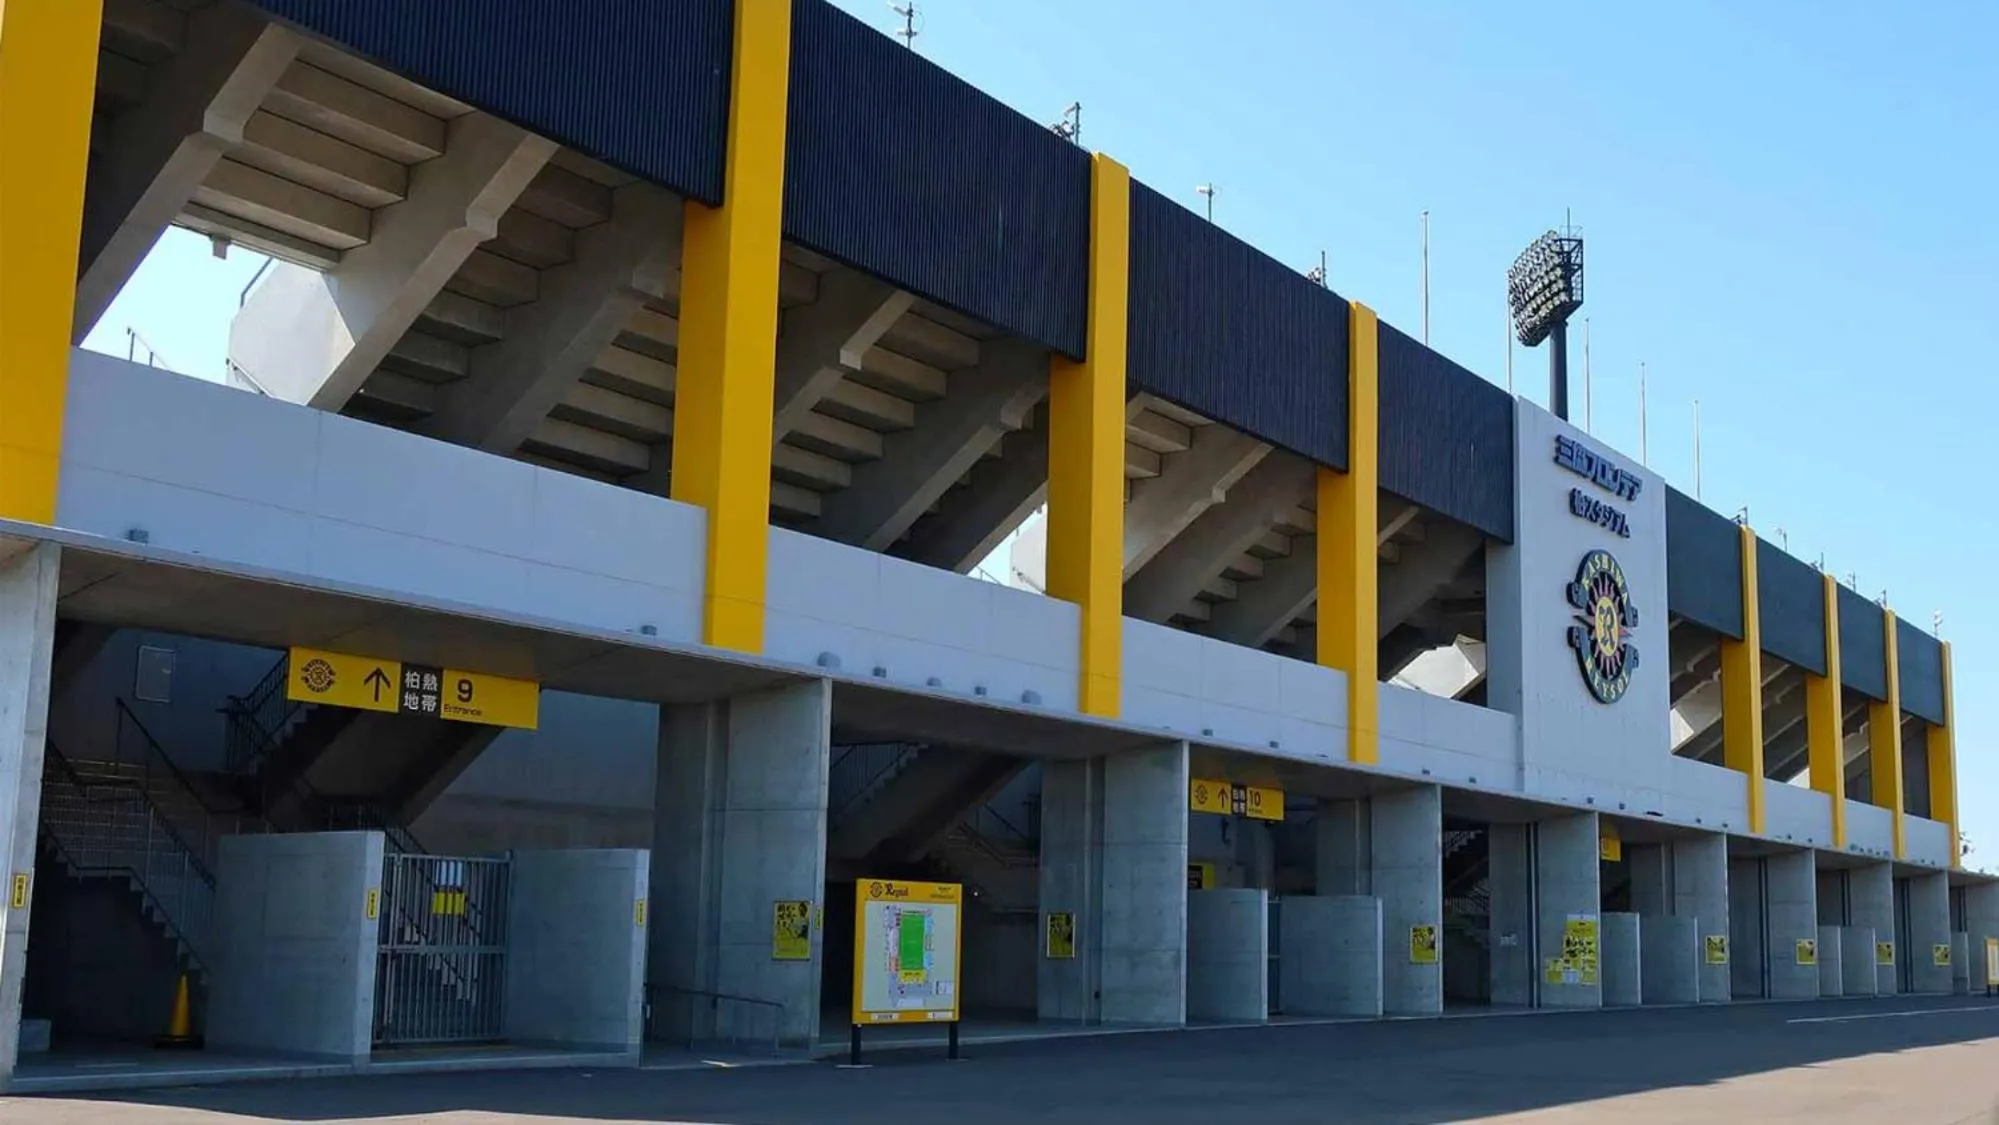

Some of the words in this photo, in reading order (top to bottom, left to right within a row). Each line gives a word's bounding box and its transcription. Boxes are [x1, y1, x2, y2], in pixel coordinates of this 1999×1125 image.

[1581, 553, 1628, 607] KASHIWA
[404, 671, 438, 692] 柏熱
[1584, 657, 1629, 700] REYSOL
[456, 678, 474, 703] 9
[403, 692, 438, 712] 地帯
[443, 703, 483, 717] Entrance
[1248, 790, 1262, 807] 10
